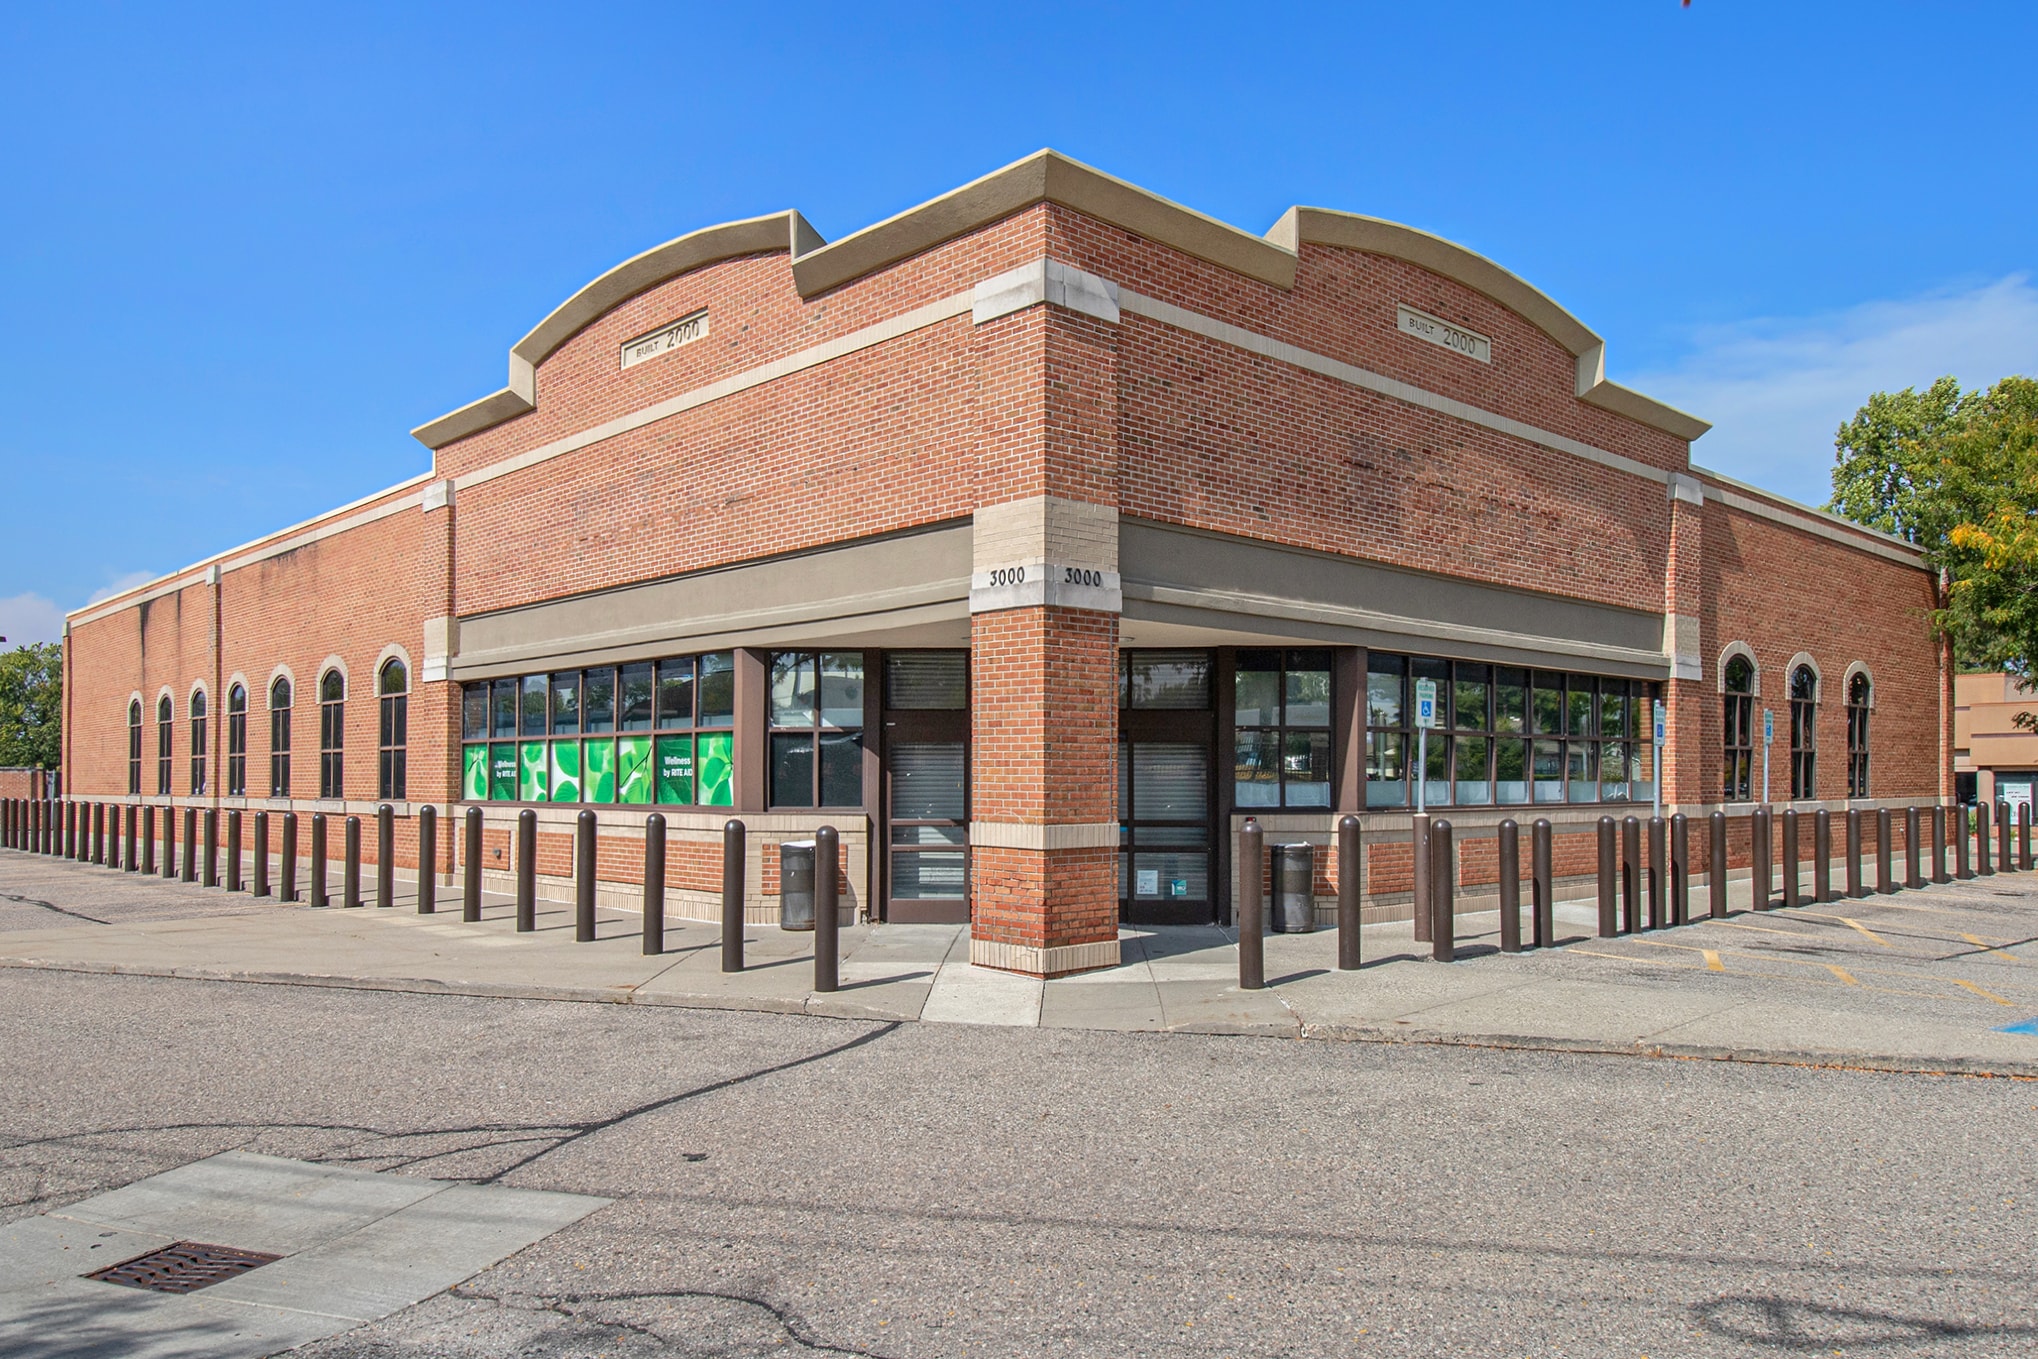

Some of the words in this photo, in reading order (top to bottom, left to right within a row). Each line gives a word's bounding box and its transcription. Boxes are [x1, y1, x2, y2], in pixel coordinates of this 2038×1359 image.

[636, 340, 659, 358] BUILT
[667, 320, 700, 348] 2000
[1409, 317, 1435, 335] BUILT
[1443, 328, 1476, 354] 2000
[989, 566, 1025, 586] 3000
[1064, 567, 1101, 587] 3000
[664, 756, 691, 765] Wellness
[663, 768, 670, 778] by
[671, 768, 683, 777] RITE
